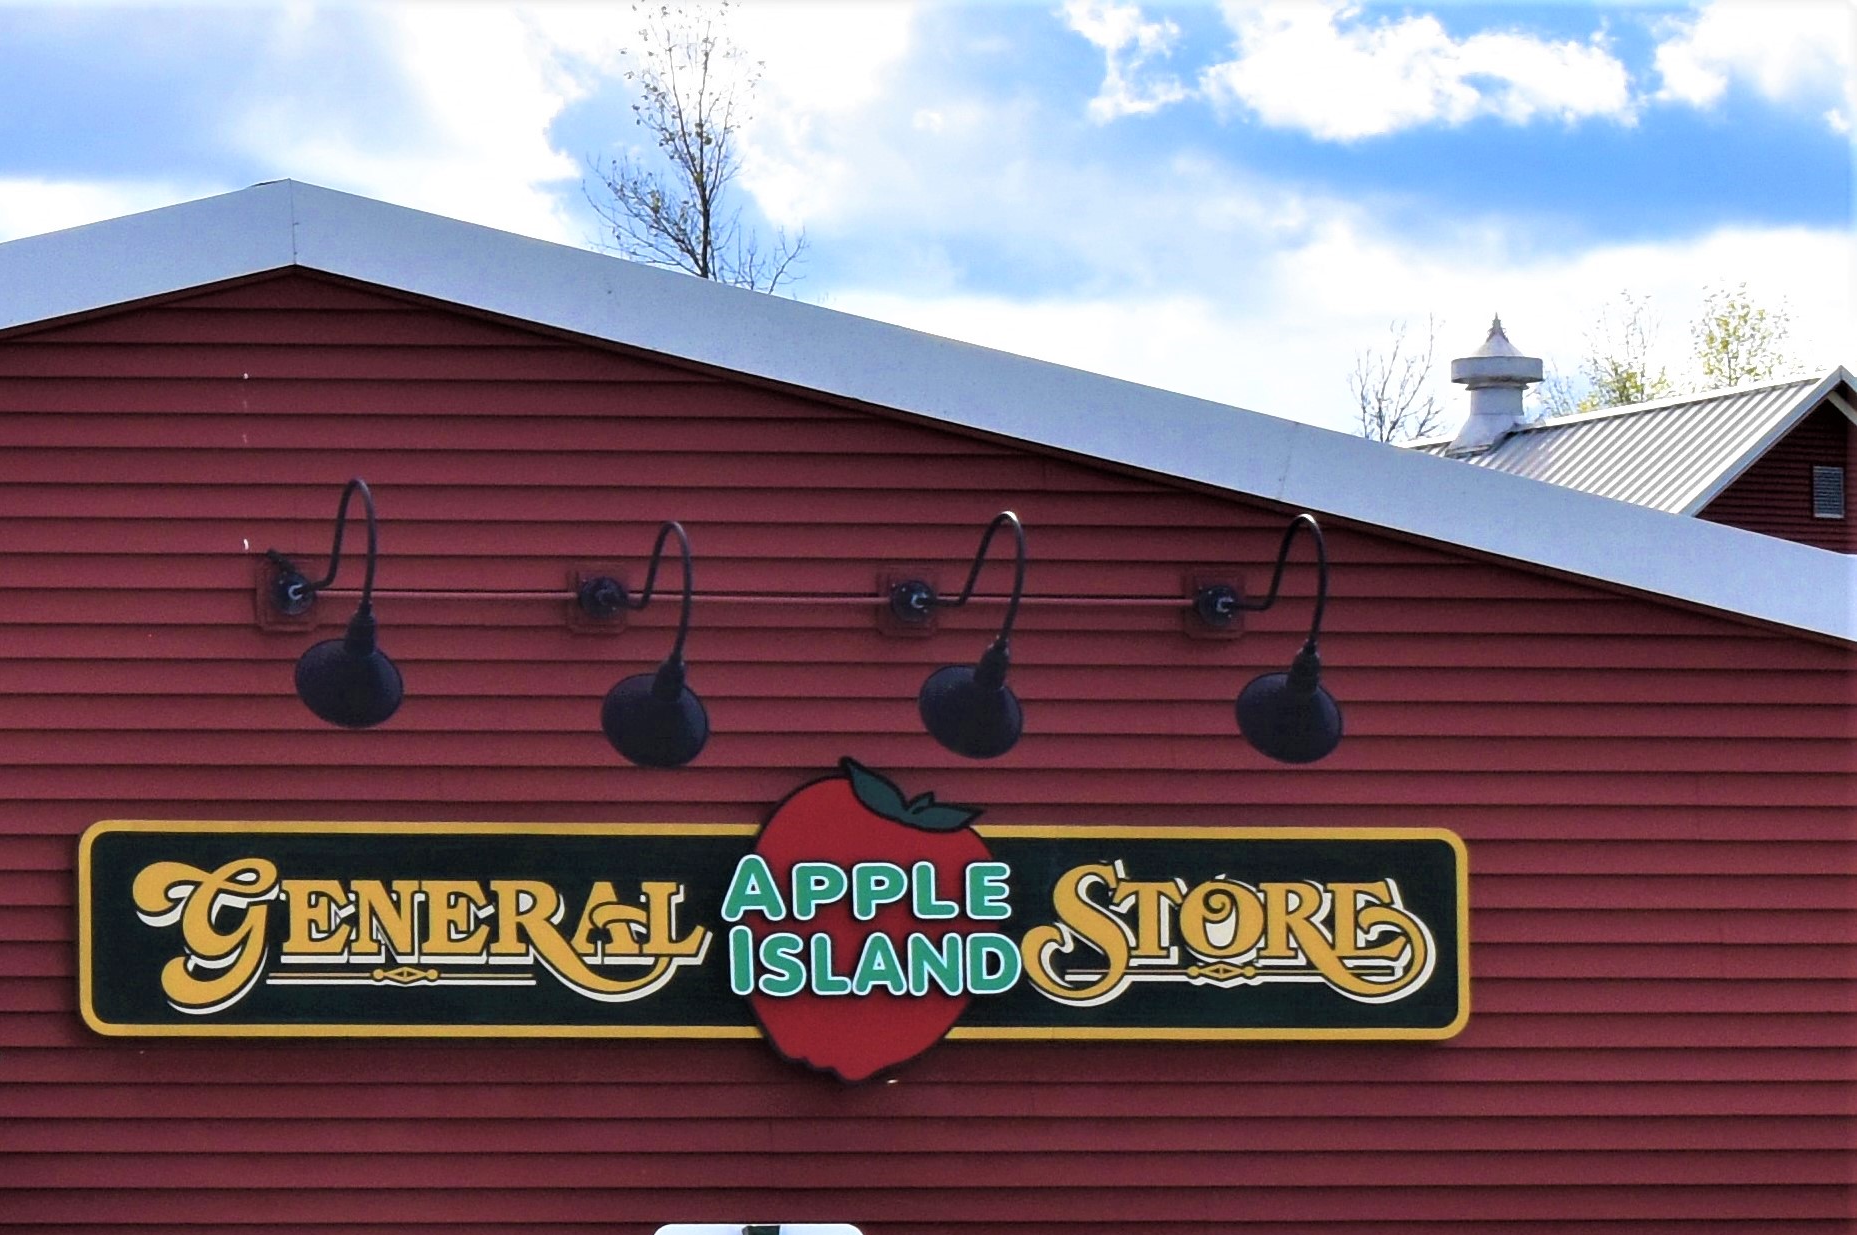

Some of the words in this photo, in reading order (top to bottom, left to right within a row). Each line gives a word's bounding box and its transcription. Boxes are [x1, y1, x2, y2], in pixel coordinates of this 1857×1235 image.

[720, 854, 1012, 921] APPLE
[132, 857, 713, 1014] GENERAL
[1021, 858, 1437, 1007] STORE
[729, 925, 1022, 997] ISLAND
